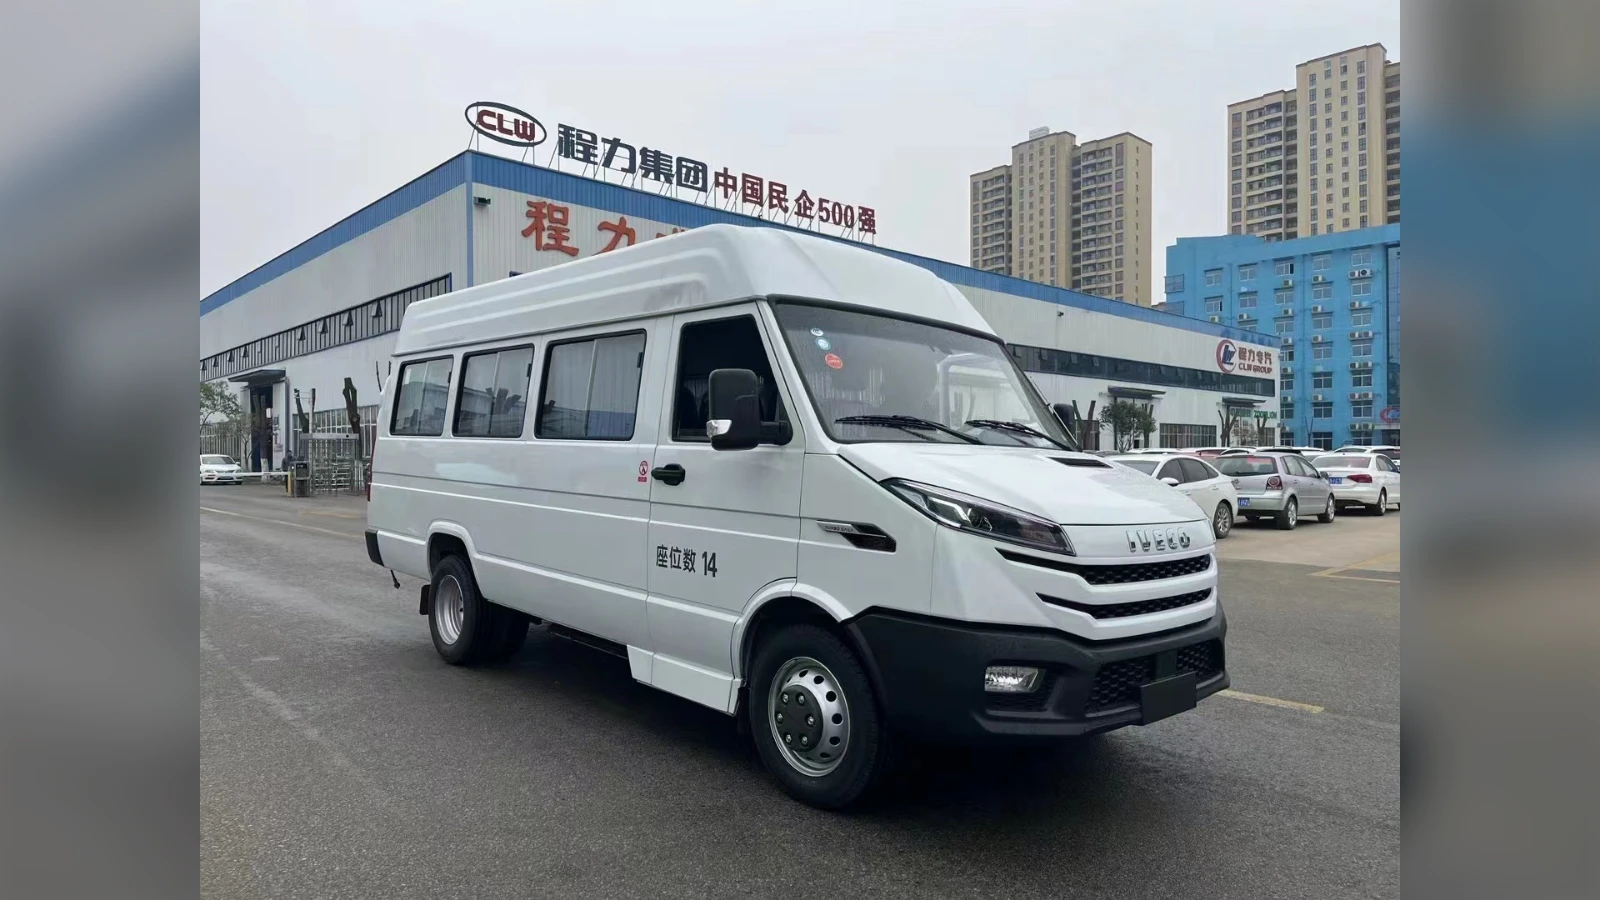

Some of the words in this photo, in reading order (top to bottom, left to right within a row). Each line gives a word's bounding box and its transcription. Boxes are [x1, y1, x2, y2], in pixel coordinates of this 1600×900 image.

[477, 109, 535, 141] CLW
[558, 123, 708, 193] 程力集团
[714, 167, 876, 235] 中国民企500强
[1253, 365, 1273, 374] GROUP
[1126, 527, 1190, 552] IVECO
[656, 545, 696, 573] 座位数
[702, 551, 718, 577] 14
